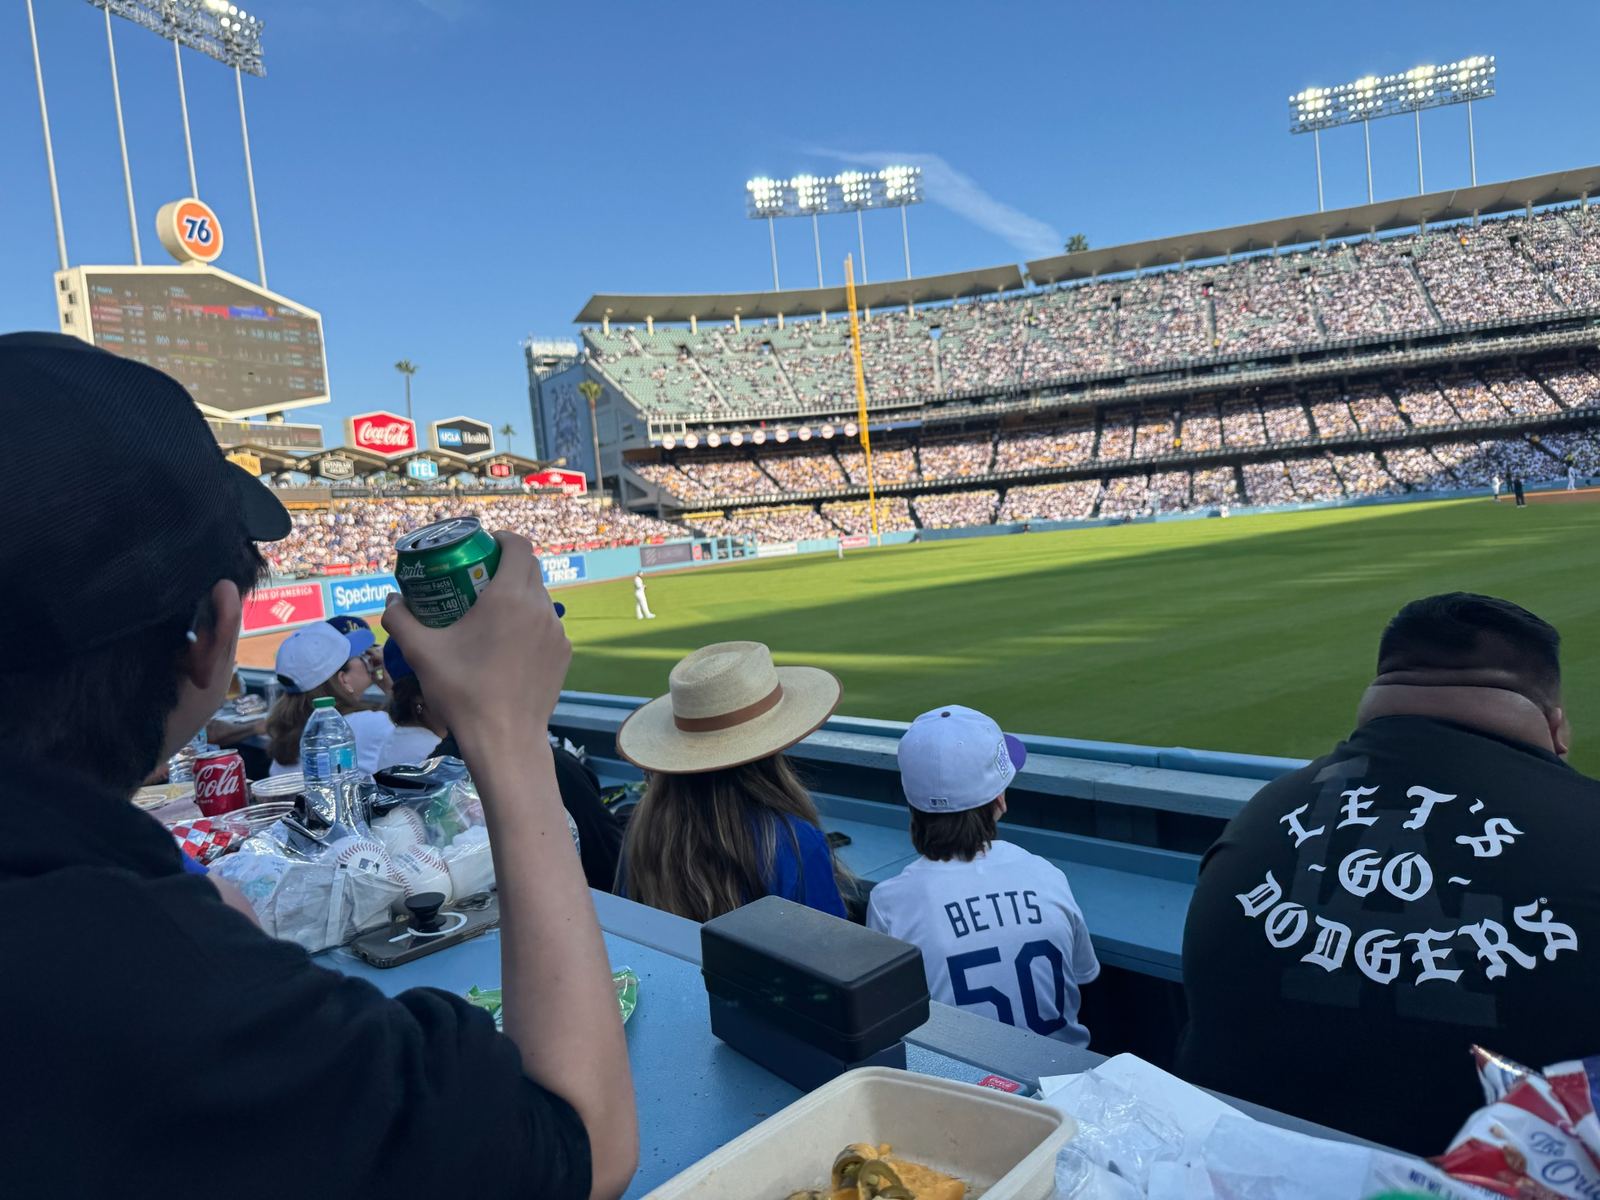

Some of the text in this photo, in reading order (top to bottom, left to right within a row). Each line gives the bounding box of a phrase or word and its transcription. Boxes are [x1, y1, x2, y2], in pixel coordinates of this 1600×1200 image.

[184, 217, 212, 245] 76
[441, 431, 489, 444] UCLA Health
[543, 557, 569, 571] TOYO
[548, 567, 578, 582] TIRES
[280, 585, 313, 599] AMERICA
[335, 583, 393, 608] Spectrum
[440, 599, 458, 610] 140
[195, 760, 242, 798] Cola
[1279, 785, 1525, 858] LET'S
[944, 890, 1042, 938] BETTS
[1235, 870, 1579, 986] DODGERS
[947, 940, 1067, 1036] 50
[1529, 1131, 1567, 1157] The
